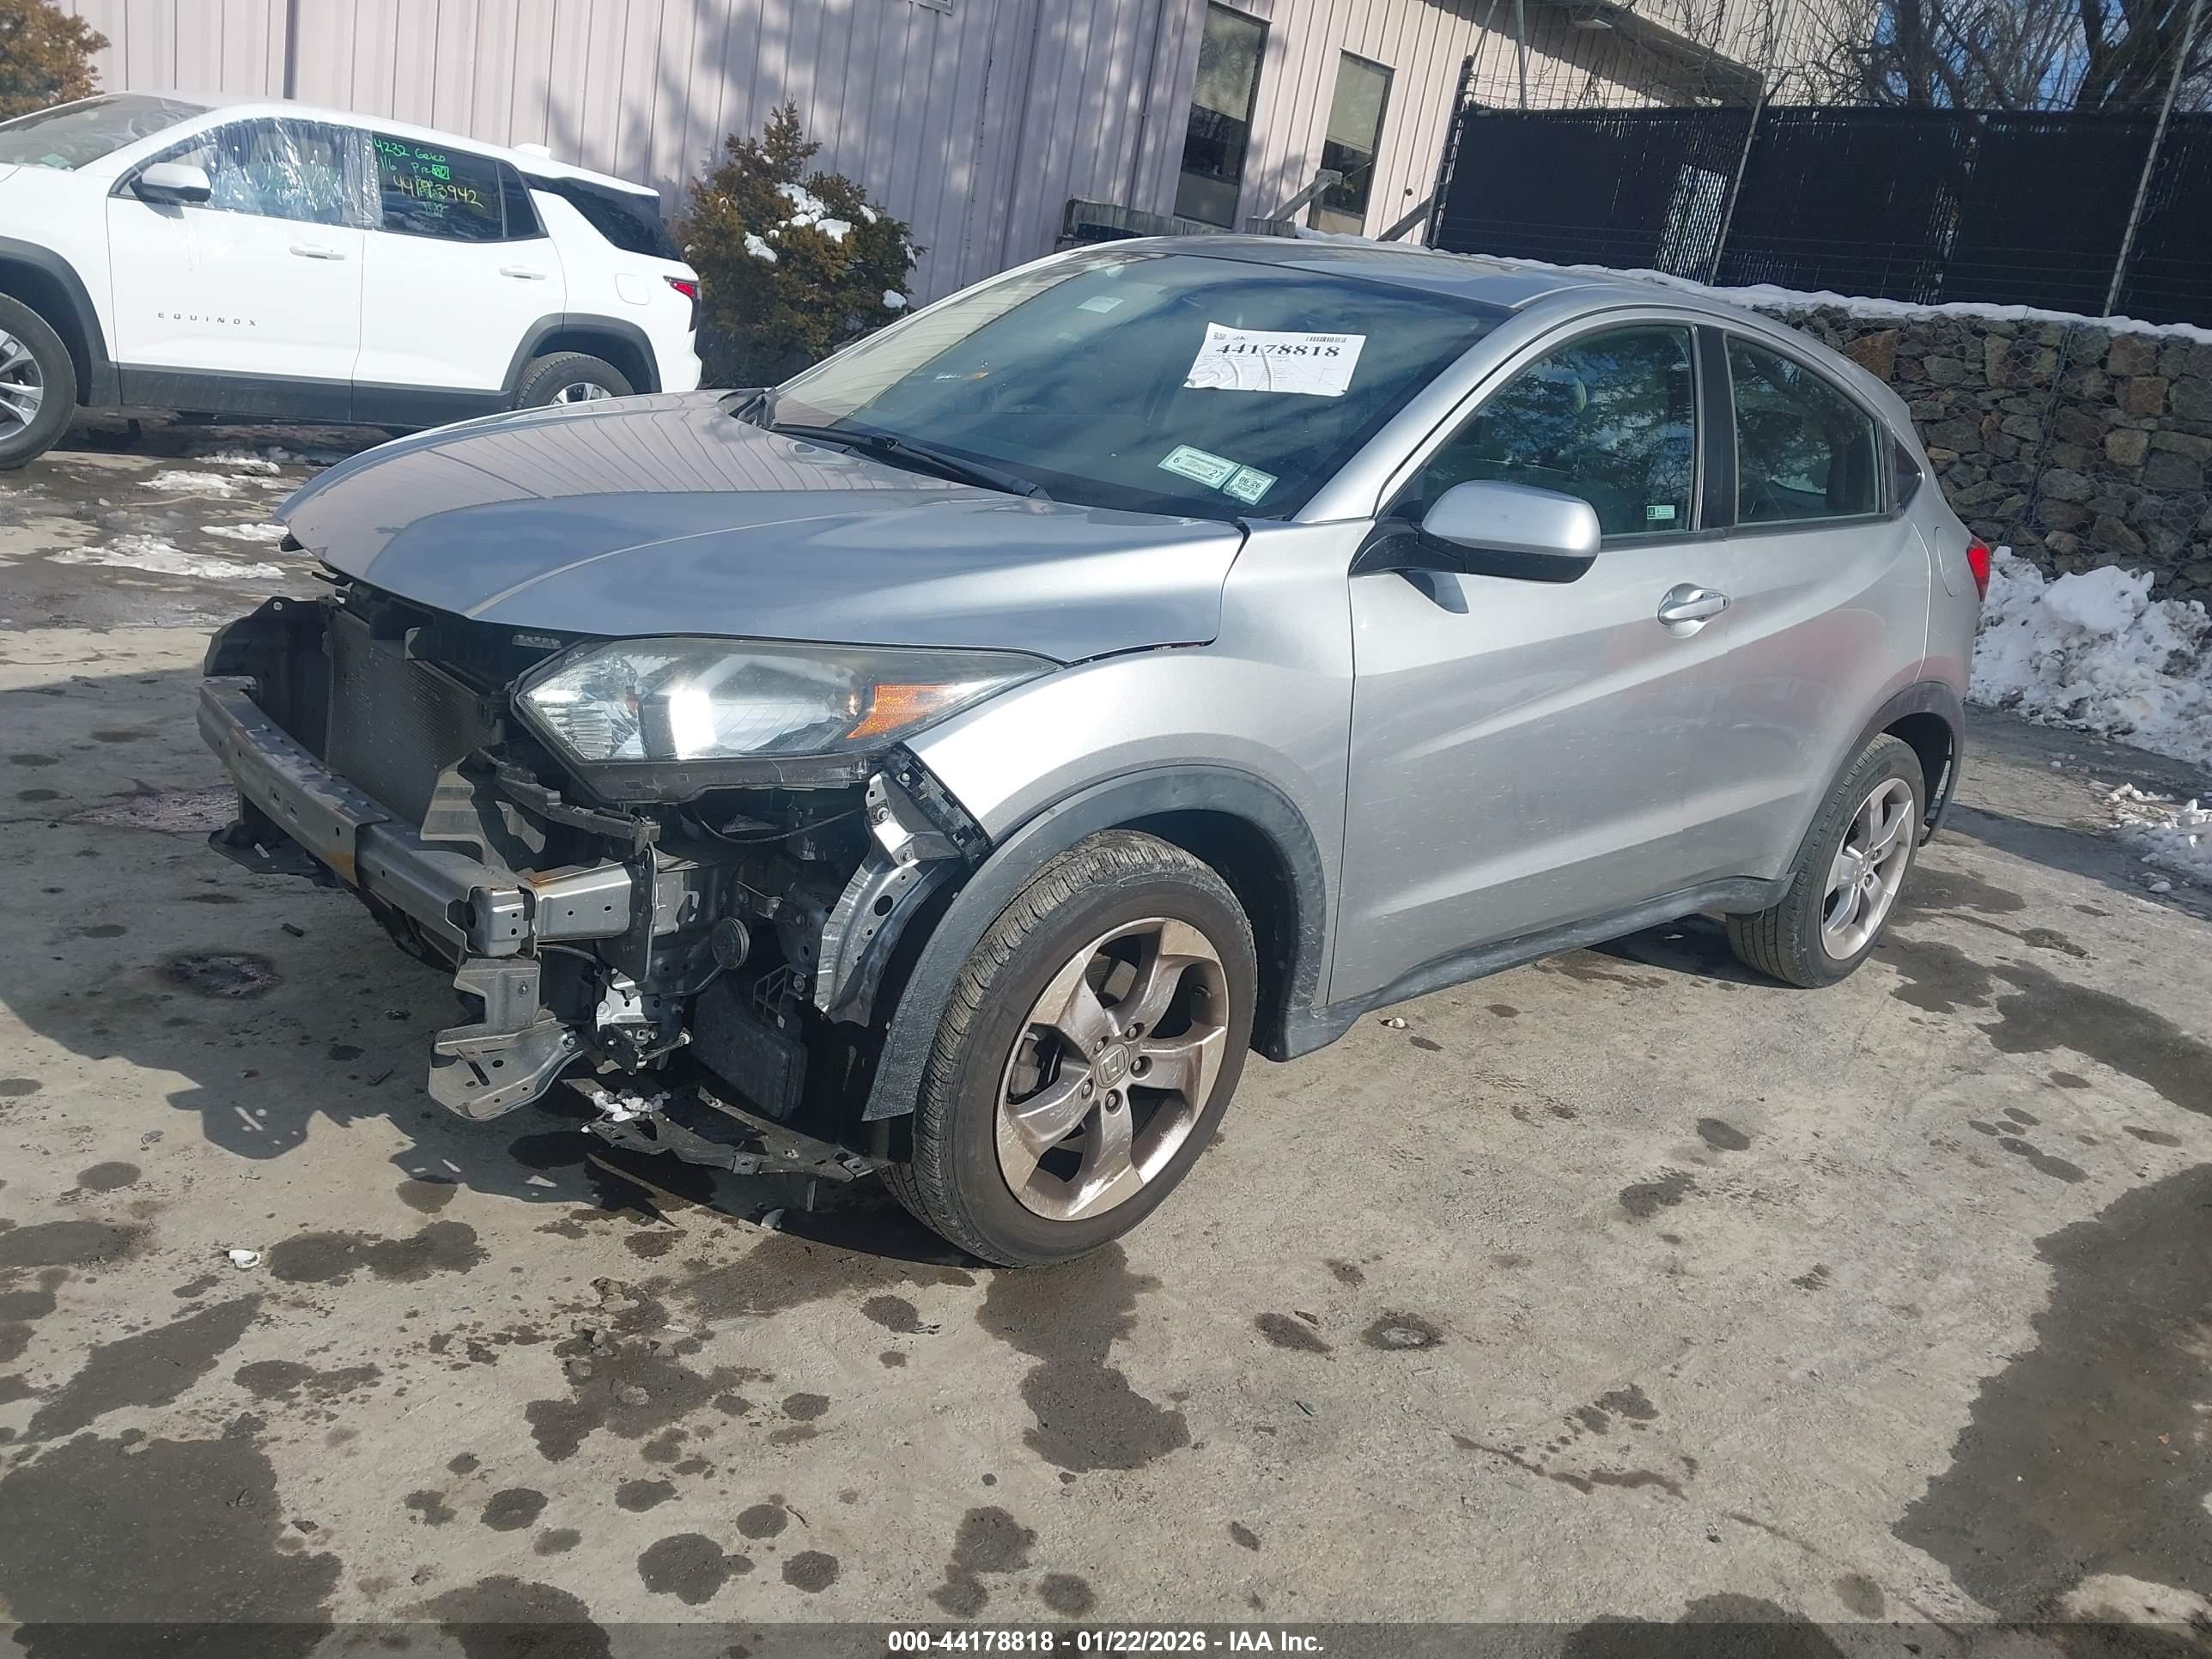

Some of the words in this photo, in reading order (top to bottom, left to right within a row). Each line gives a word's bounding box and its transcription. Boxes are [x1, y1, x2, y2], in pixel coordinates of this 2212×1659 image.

[374, 137, 410, 156] 4232
[157, 312, 257, 327] EQUINOX
[1216, 343, 1341, 357] 44178818
[1208, 469, 1225, 479] 27
